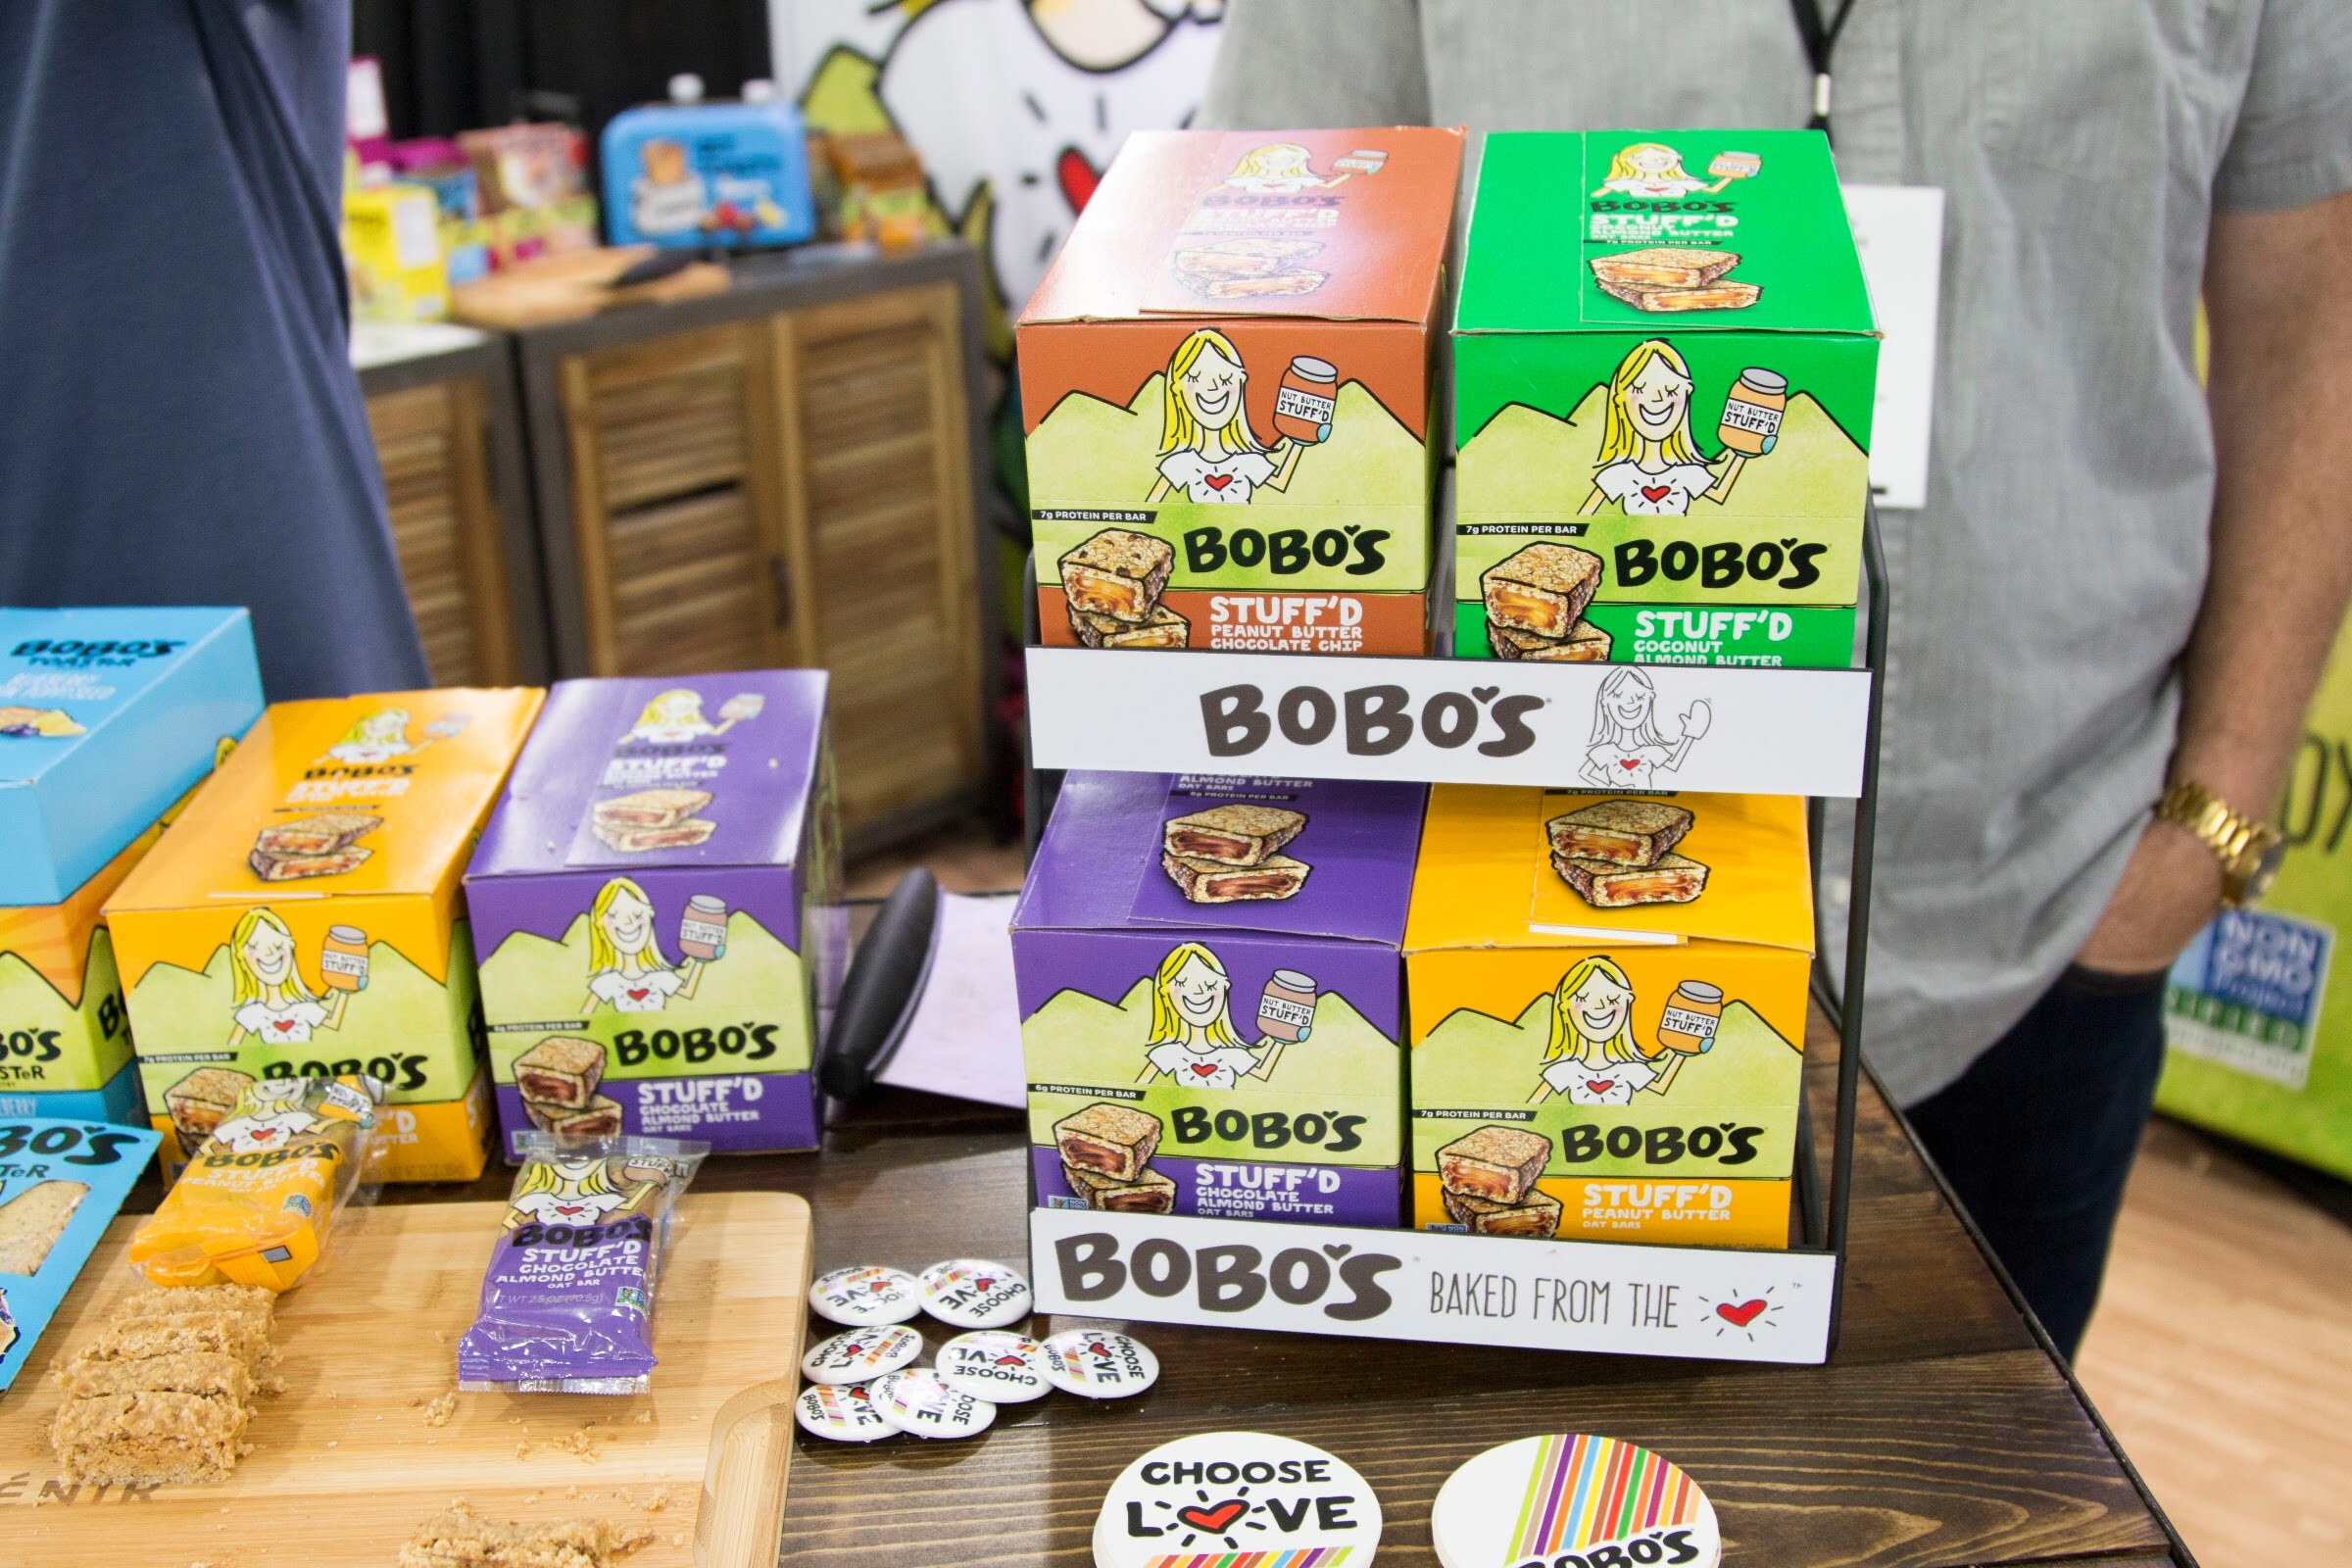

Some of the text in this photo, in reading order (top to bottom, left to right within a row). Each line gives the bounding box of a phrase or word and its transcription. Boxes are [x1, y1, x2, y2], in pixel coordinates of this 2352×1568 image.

[1590, 200, 1738, 213] BOBO'S
[1591, 214, 1739, 227] STUFF'D
[1279, 400, 1330, 421] STUFF'D
[1282, 391, 1332, 410] NUT BUTTER
[1728, 402, 1779, 421] NUT BUTTER
[1725, 412, 1776, 433] STUFF'D
[1040, 511, 1053, 519] 7g
[1125, 513, 1147, 521] BAR
[1466, 525, 1479, 534] 7g
[1554, 525, 1577, 534] BAR
[1184, 524, 1392, 575] BOBO'S
[1613, 537, 1829, 590] BOBO'S
[1210, 595, 1363, 626] STUFF'D
[1211, 624, 1363, 639] PEANUT BUTTER
[1635, 610, 1792, 641] STUFF'D
[1210, 638, 1363, 652] CHOCOLATE CHIP
[1634, 640, 1723, 654] COCONUT
[1634, 654, 1782, 667] ALMOND BUTTER
[1200, 683, 1546, 759] BOBO'S
[1179, 775, 1313, 788] ALMOND BUTTER
[1261, 1005, 1309, 1025] STUFF'D
[1263, 998, 1311, 1015] NUT BUTTER
[1664, 1017, 1713, 1036] STUFF'D
[1667, 1009, 1716, 1026] NUT BUTTER
[613, 1022, 779, 1066] BOBO'S
[638, 1077, 763, 1104] STUFF'D
[1050, 1085, 1093, 1095] PROTEIN
[639, 1102, 729, 1116] CHOCOLATE
[642, 1110, 760, 1126] ALMOND BUTTER
[1171, 1105, 1368, 1152] BOBO'S
[1562, 1122, 1765, 1164] BOBO'S
[1196, 1163, 1341, 1194] STUFF'D
[1196, 1187, 1299, 1202] CHOCOLATE
[1583, 1183, 1733, 1209] STUFF'D
[1197, 1198, 1334, 1214] ALMOND BUTTER
[1583, 1208, 1731, 1221] PEANUT BUTTER
[522, 1241, 642, 1263] STUFF'D
[518, 1255, 639, 1274] CHOCOLATE
[495, 1267, 646, 1284] ALMOND BUTTE
[1054, 1232, 1402, 1321] BOBO'S
[509, 1295, 525, 1303] WT
[968, 1283, 1027, 1318] CHOOSE
[1430, 1271, 1680, 1328] BAKED FROM THE
[888, 1334, 916, 1358] BOBO'S
[1114, 1335, 1145, 1379] CHOOSE
[954, 1365, 1038, 1386] CHOOSE
[803, 1395, 825, 1421] BOBO'S
[953, 1394, 975, 1426] OOSE
[1141, 1459, 1332, 1484] CHOOSE
[1518, 1530, 1699, 1568] OBO'S
